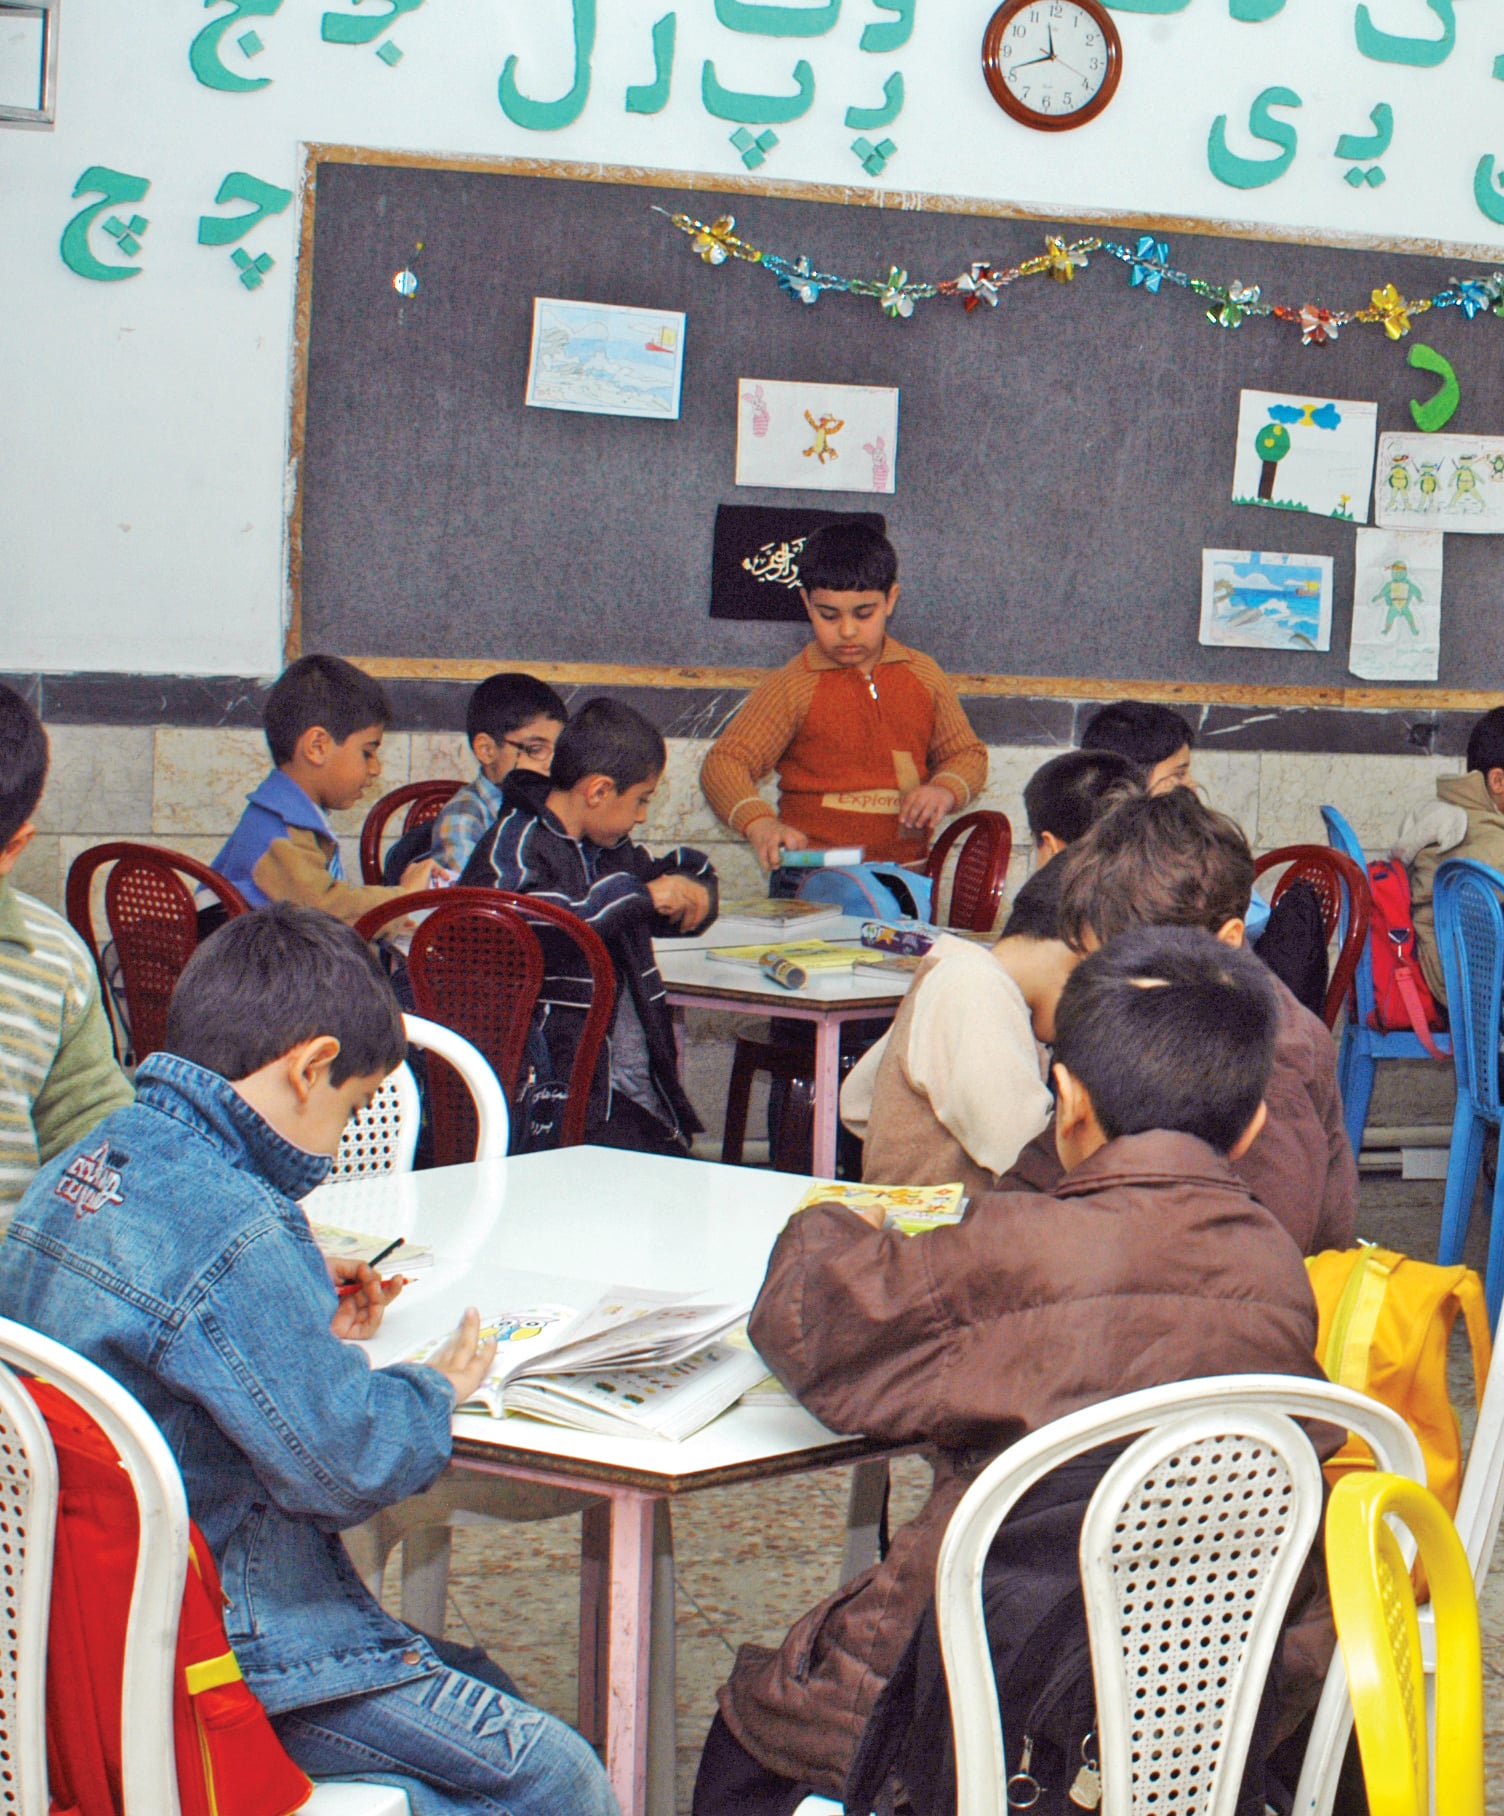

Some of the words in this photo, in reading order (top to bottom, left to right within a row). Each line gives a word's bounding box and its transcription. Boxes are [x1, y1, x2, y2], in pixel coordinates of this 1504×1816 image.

[1029, 10, 1040, 24] 11
[1049, 4, 1063, 18] 12
[1011, 24, 1027, 38] 10
[1084, 33, 1095, 48] 2
[1003, 45, 1013, 58] 9
[1089, 57, 1099, 71] 3
[1007, 68, 1018, 83] 8
[1081, 77, 1090, 91] 4
[1022, 85, 1031, 99] 7
[1062, 91, 1073, 105] 5
[1041, 95, 1052, 109] 6
